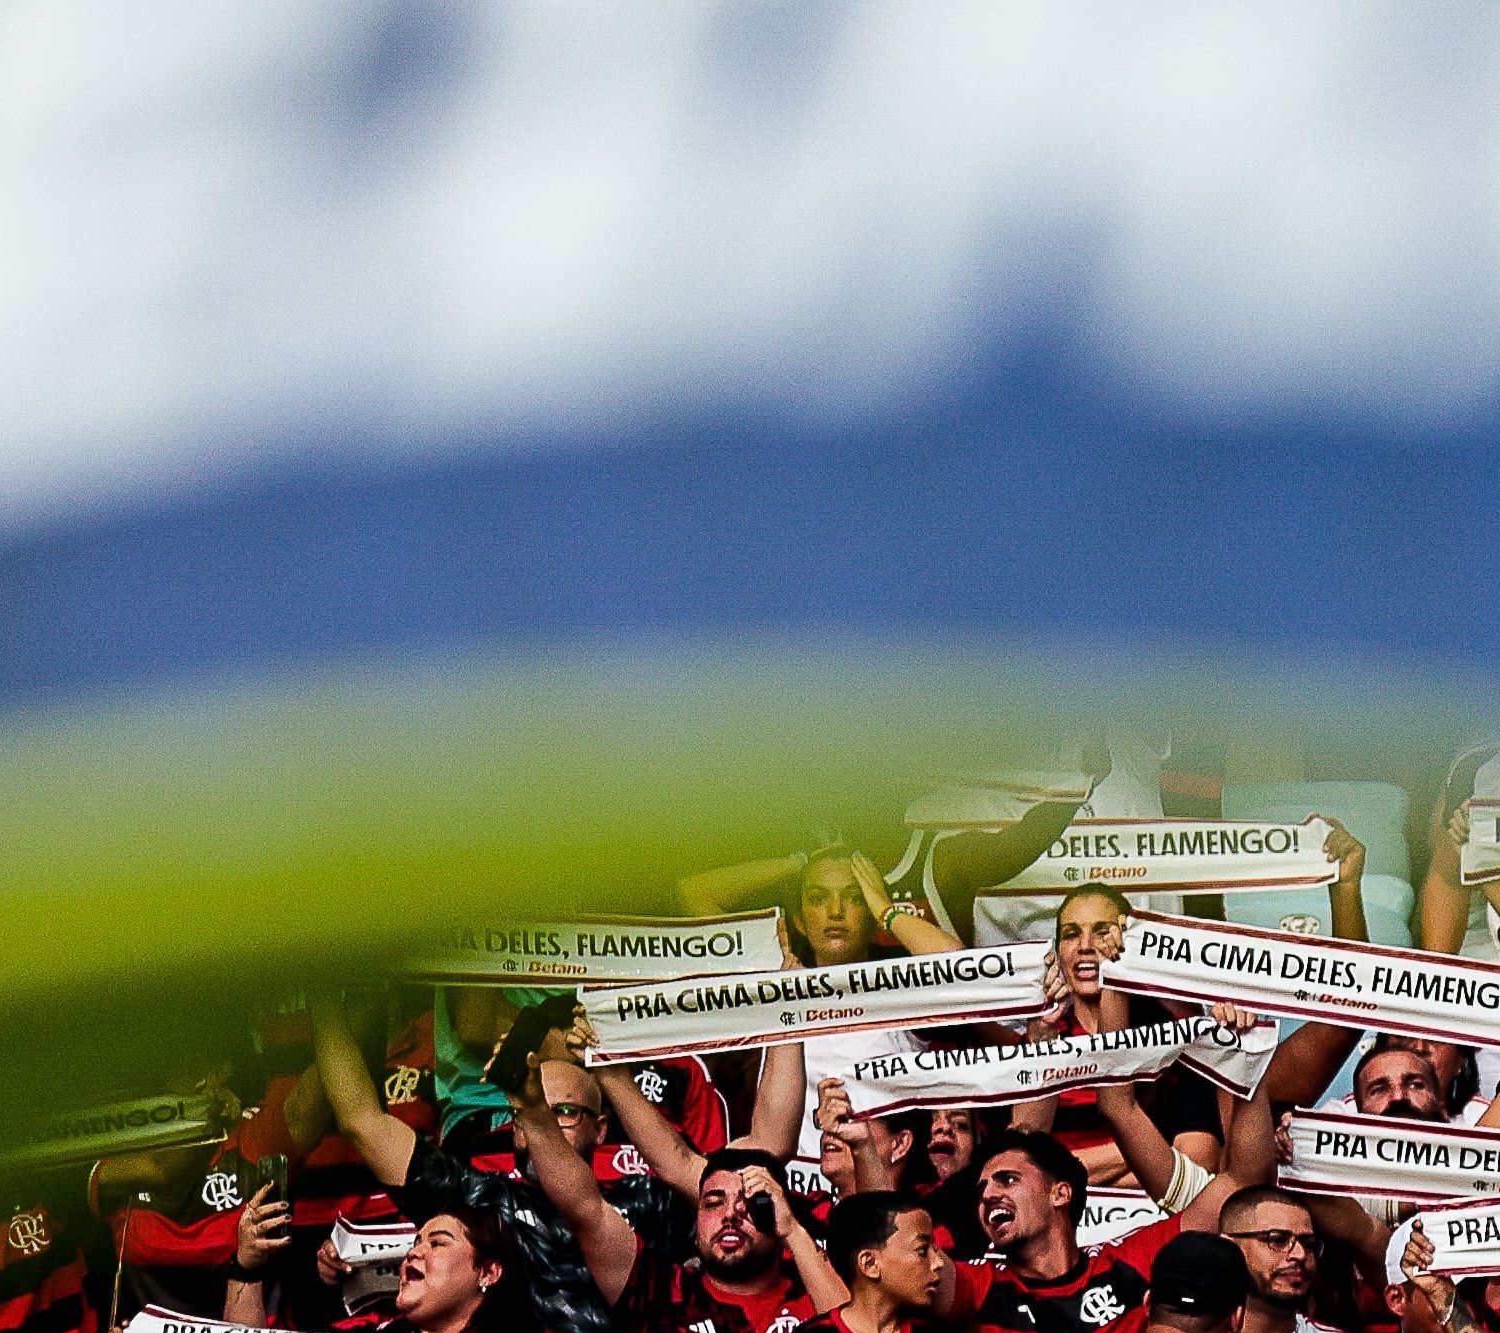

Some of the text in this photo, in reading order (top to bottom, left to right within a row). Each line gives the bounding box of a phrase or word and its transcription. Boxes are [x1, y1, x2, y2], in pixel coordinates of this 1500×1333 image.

[1089, 867, 1147, 879] Betano
[529, 961, 587, 974] Betano
[1140, 931, 1191, 963] PRA
[1201, 943, 1271, 976] CIMA
[1281, 954, 1362, 992] DELES,
[805, 1005, 864, 1024] Betano
[1447, 1217, 1500, 1246] PRA
